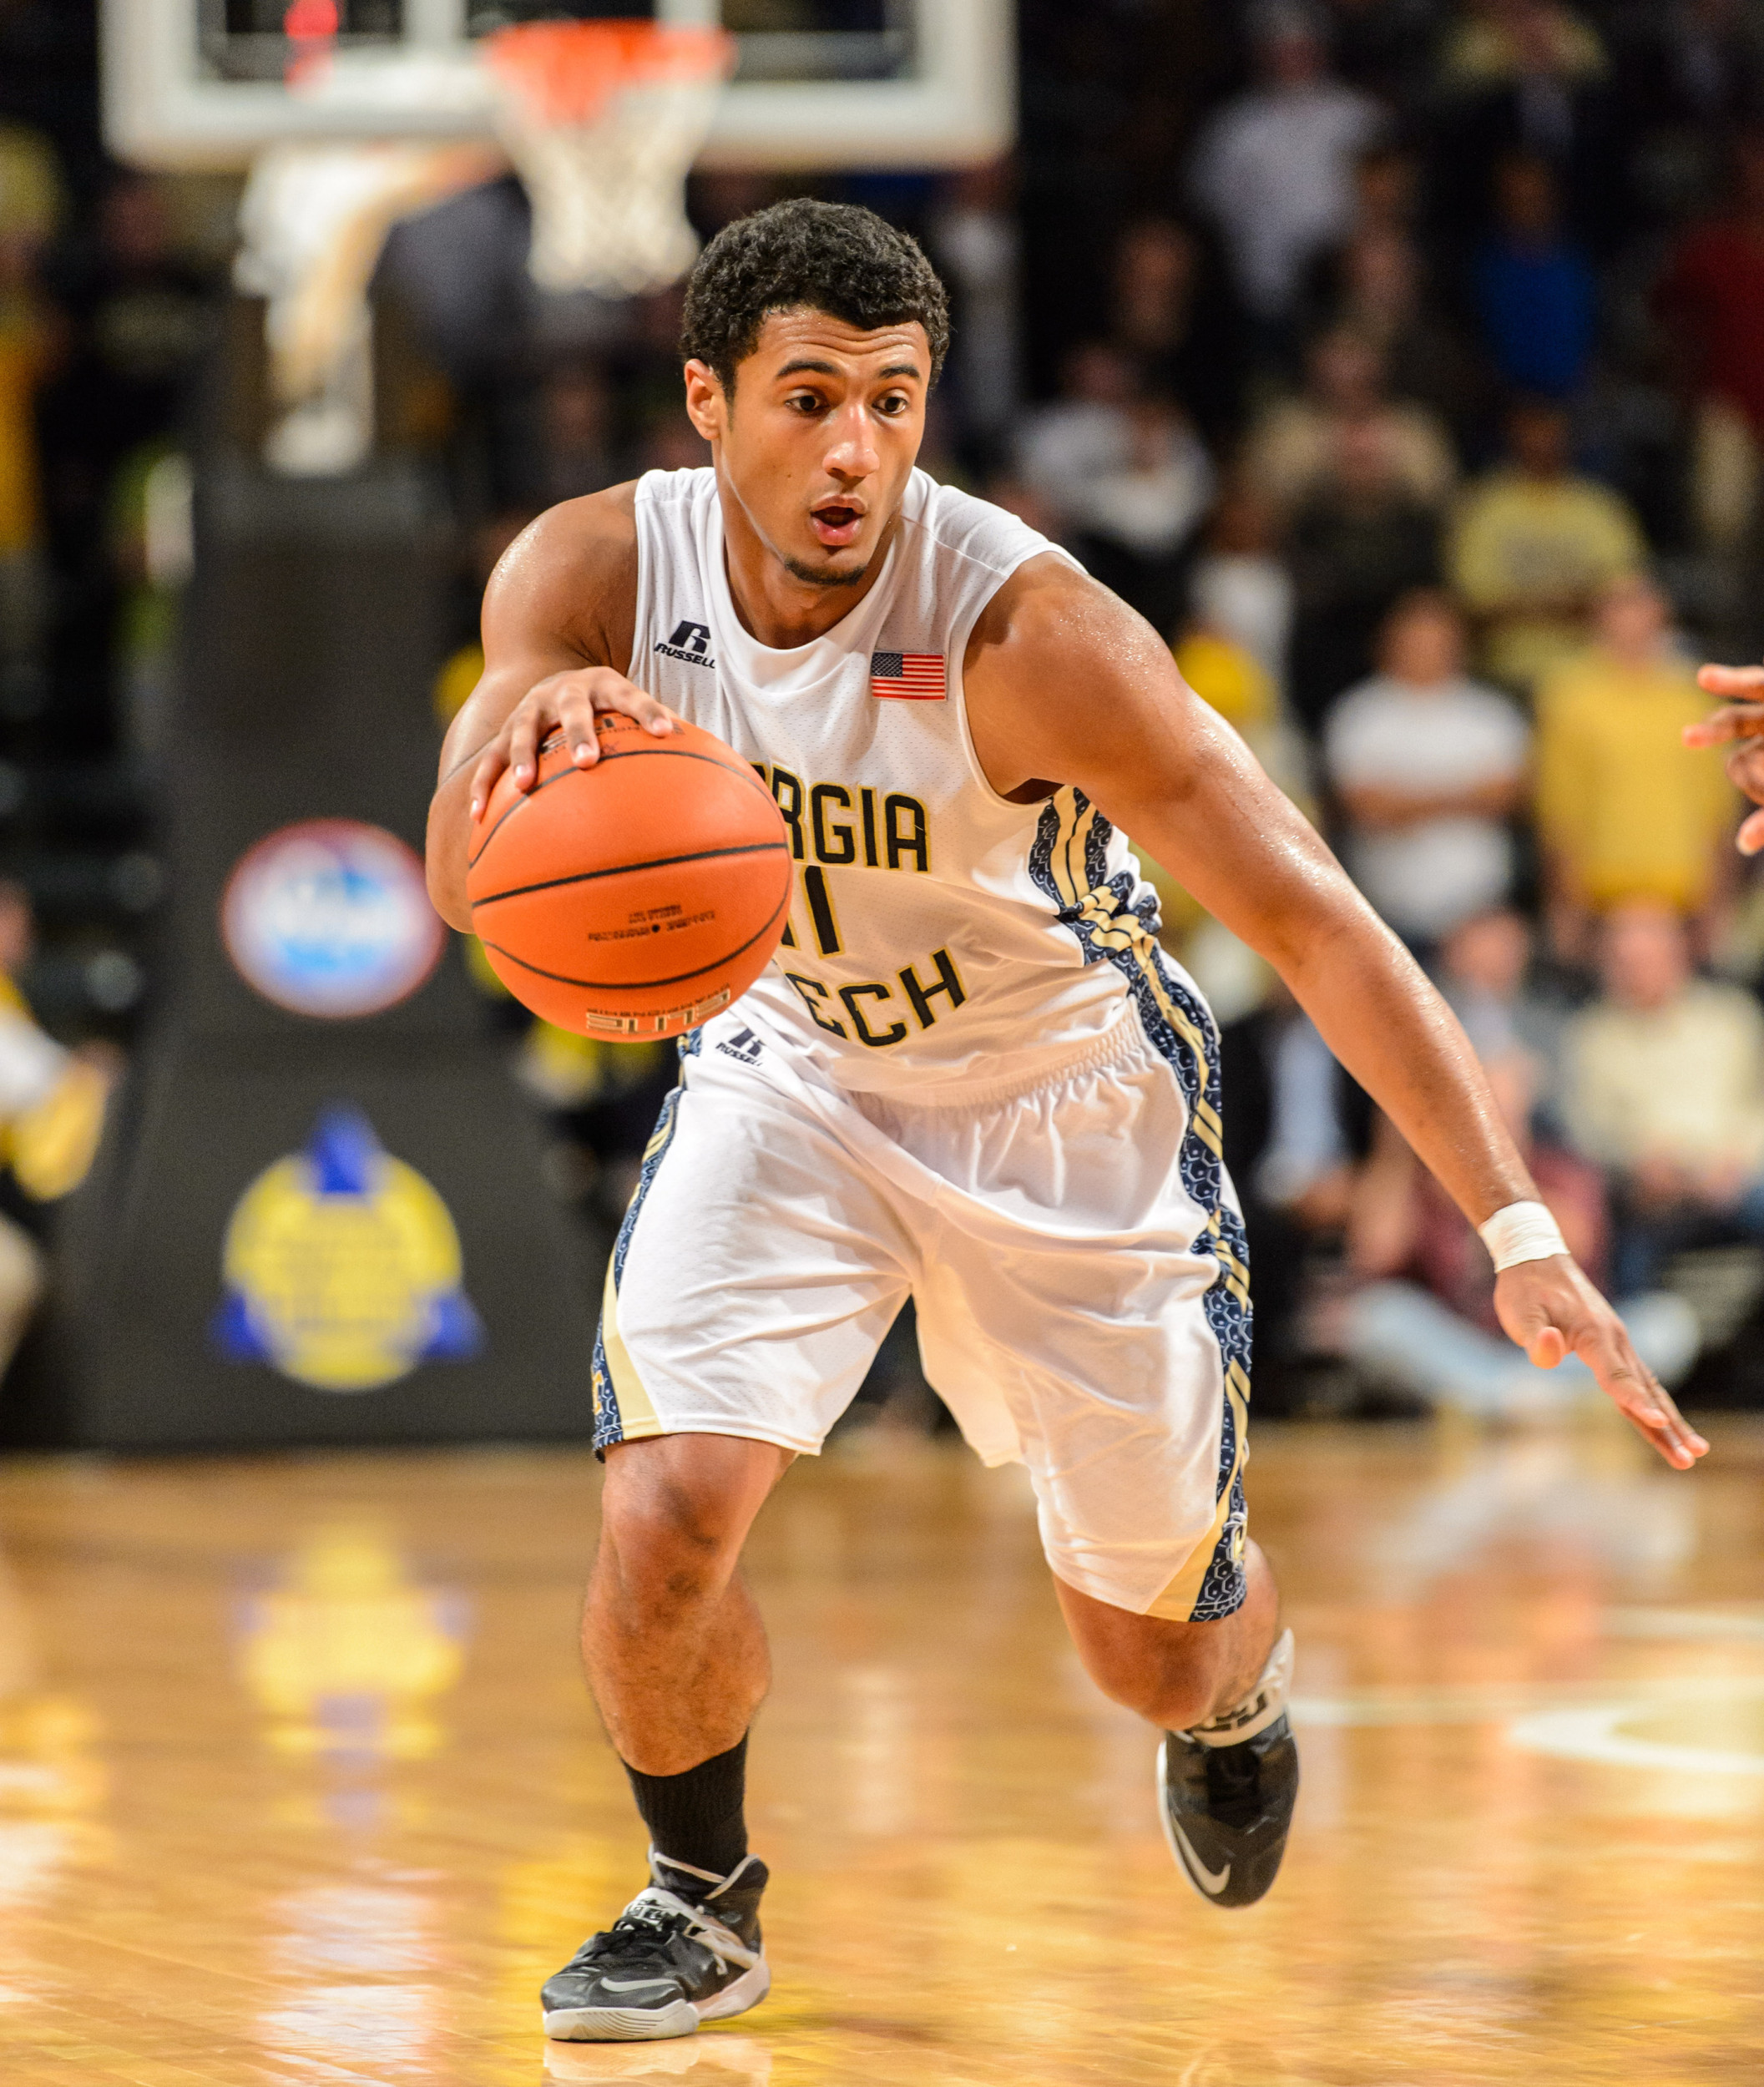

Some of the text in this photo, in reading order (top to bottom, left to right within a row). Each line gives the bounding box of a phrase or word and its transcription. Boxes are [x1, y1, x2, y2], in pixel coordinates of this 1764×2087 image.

[654, 643, 715, 669] RUSSELL
[751, 761, 932, 872] RGIA
[780, 865, 846, 959] 1
[782, 944, 968, 1049] ECH
